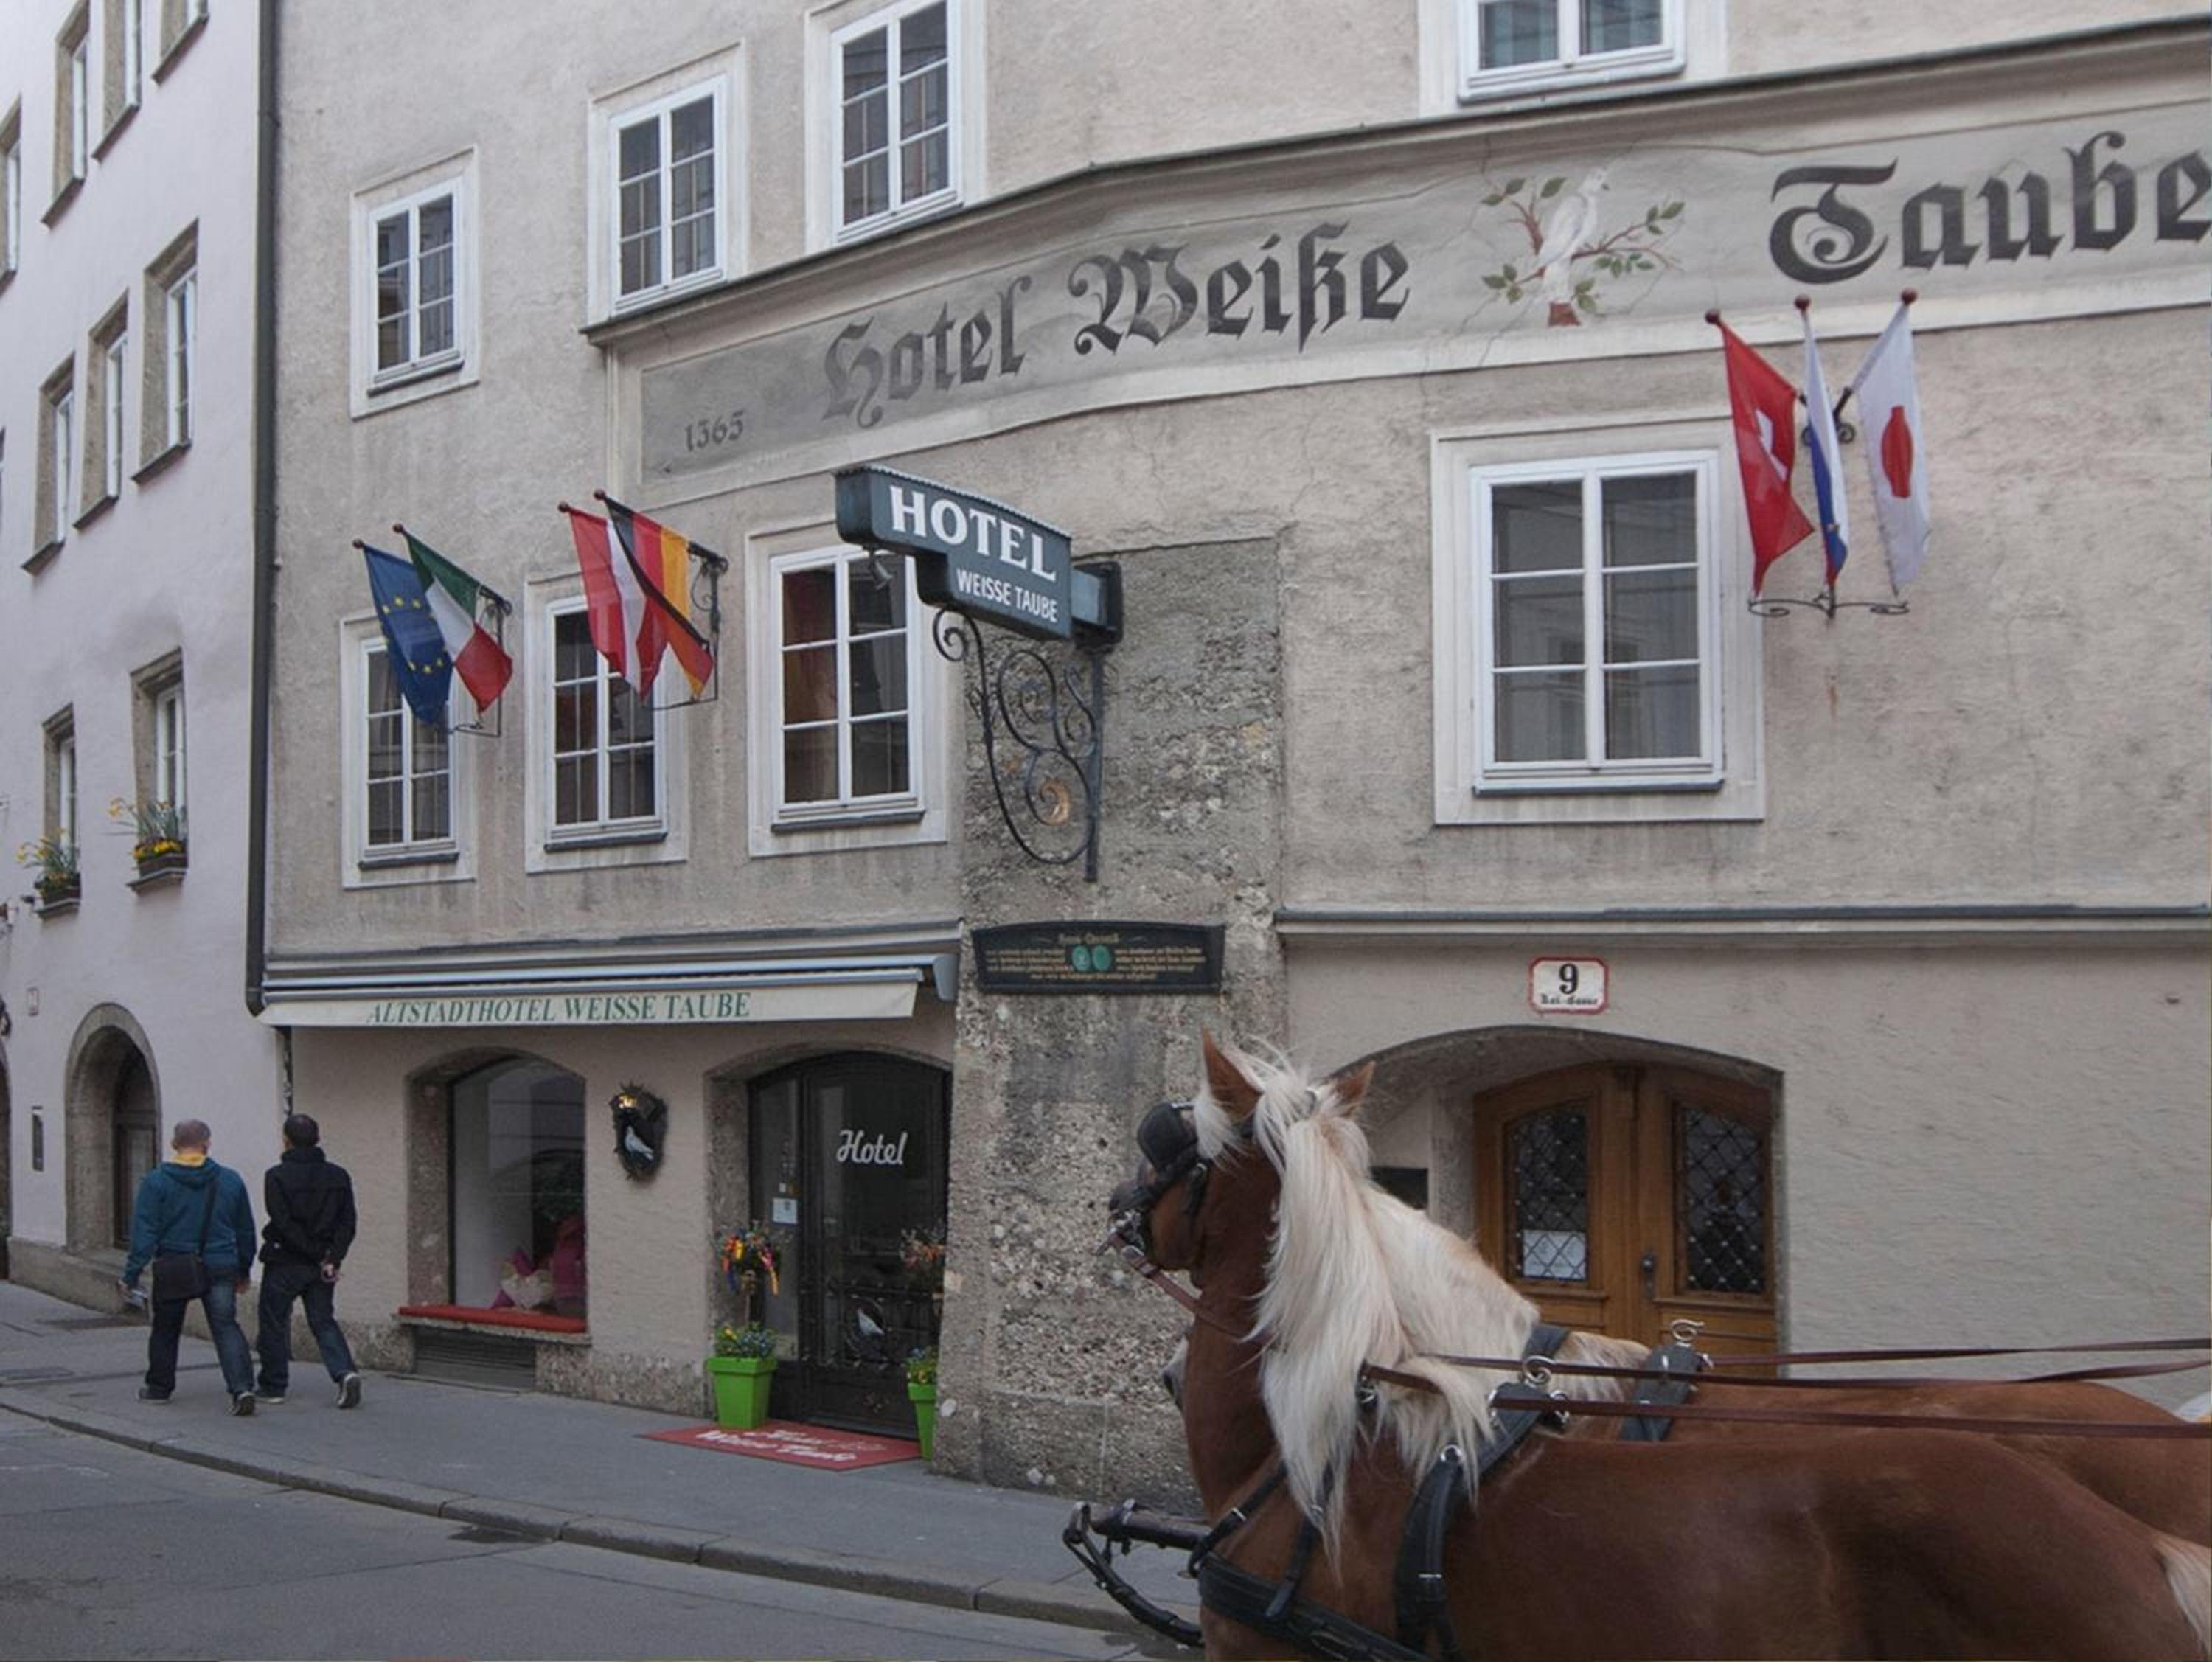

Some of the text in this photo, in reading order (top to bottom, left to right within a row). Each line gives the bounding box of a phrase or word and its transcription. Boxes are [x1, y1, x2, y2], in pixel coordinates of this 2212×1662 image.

[821, 275, 1032, 430] Hotel
[1769, 130, 2212, 285] Taube
[684, 408, 746, 452] 1365
[889, 484, 1057, 583] HOTEL
[956, 567, 1059, 624] WEISSE TAUBE
[1559, 962, 1579, 995] 9
[366, 992, 752, 1023] ALTSTADTHOTEL WEISSE TAUBE
[835, 1129, 909, 1166] Hotel
